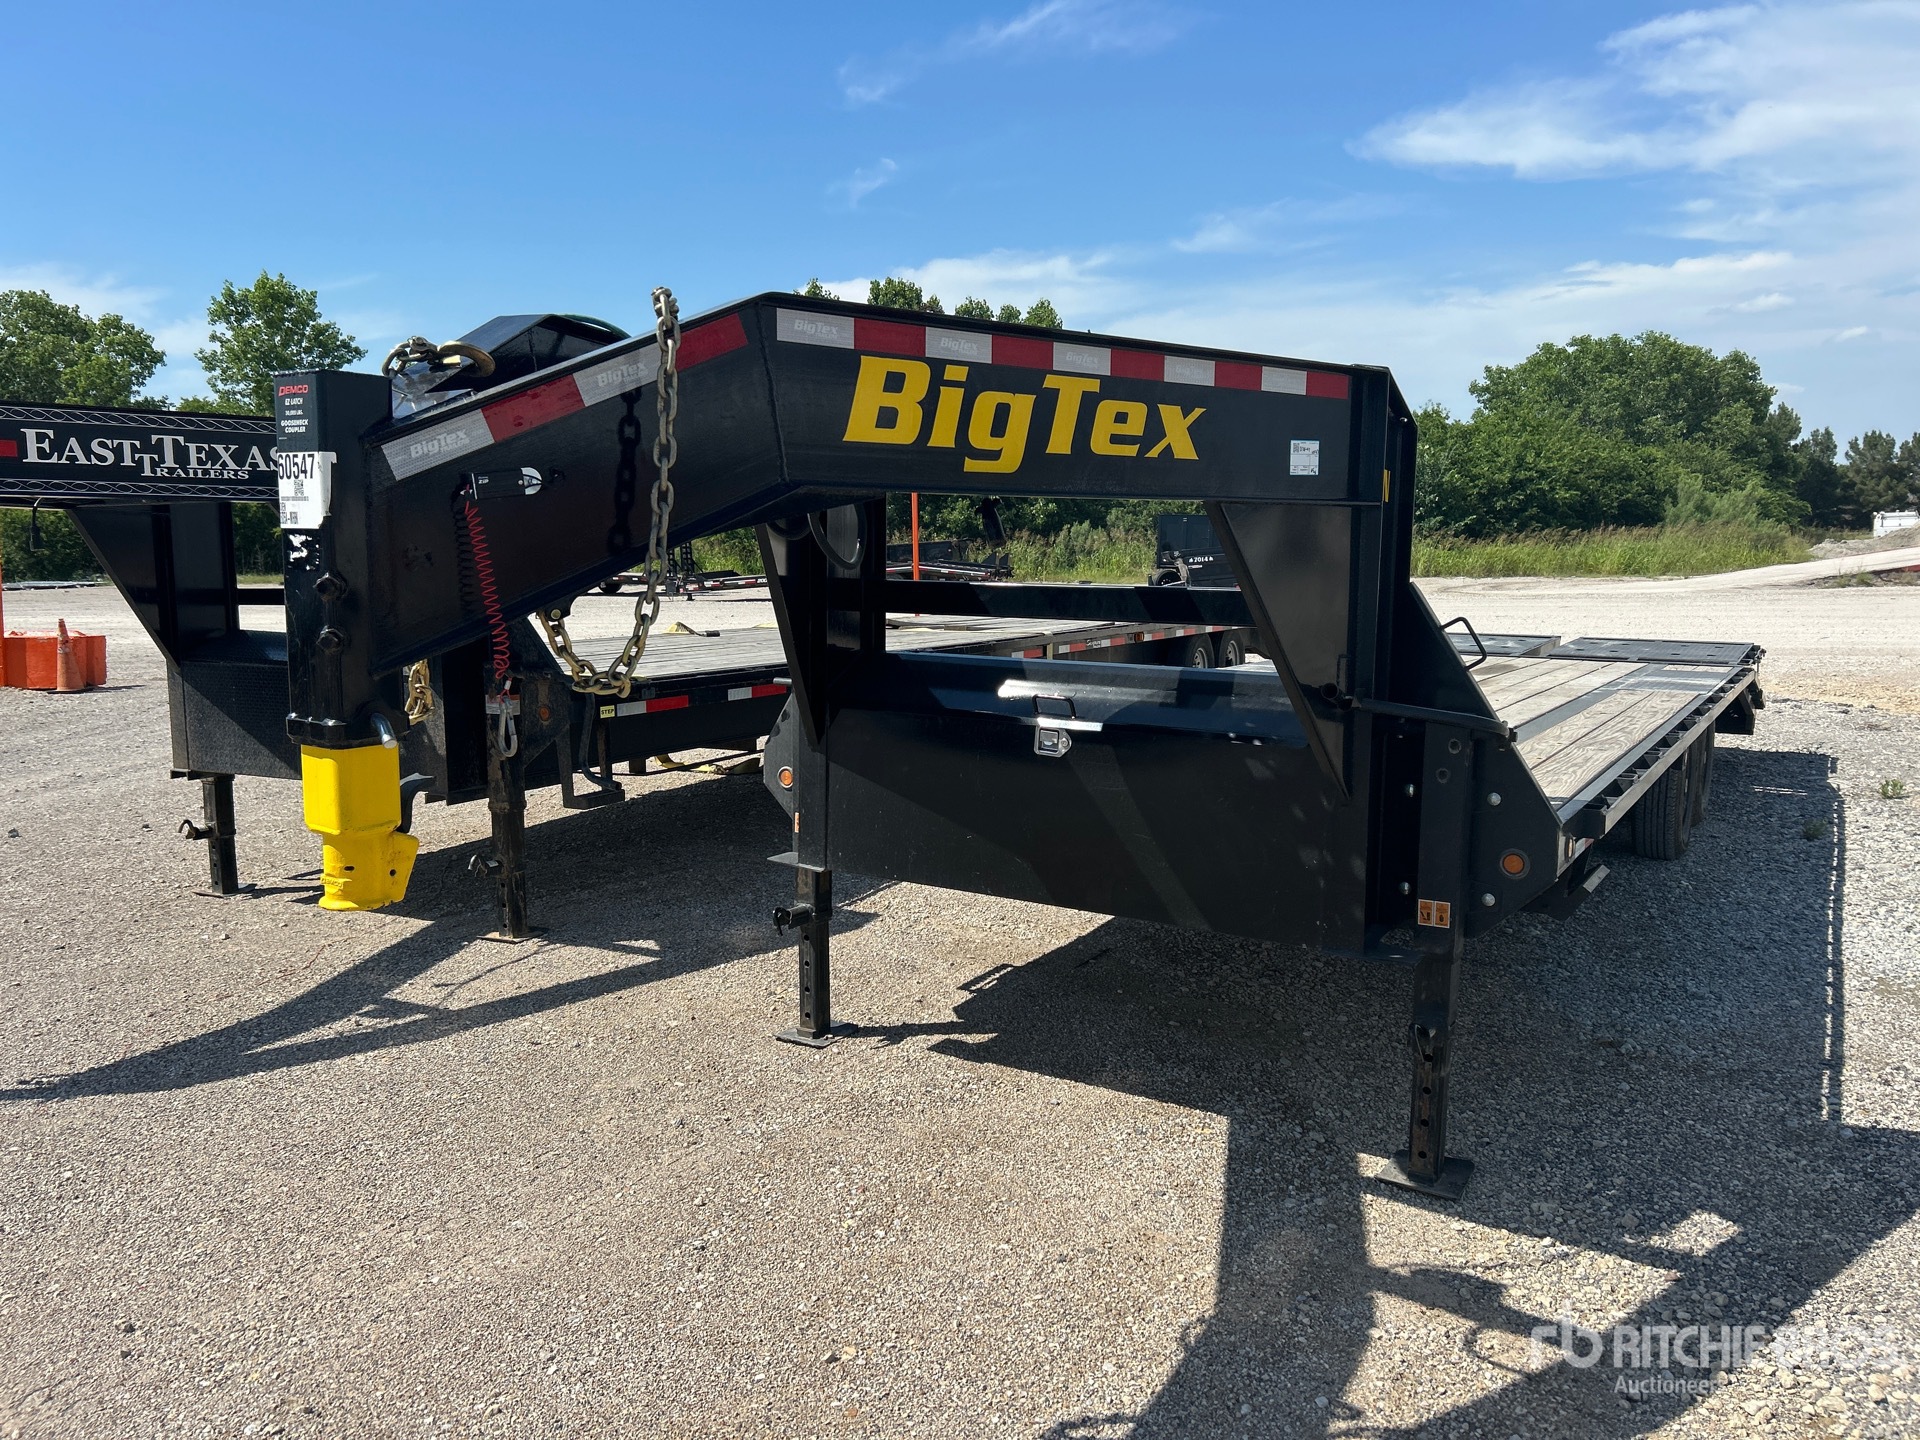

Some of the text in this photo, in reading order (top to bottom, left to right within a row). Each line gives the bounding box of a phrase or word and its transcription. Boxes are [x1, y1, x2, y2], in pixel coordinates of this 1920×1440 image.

[794, 319, 838, 335] BigTex
[941, 337, 978, 351] BigTex
[596, 362, 646, 387] BigTex
[279, 385, 308, 396] DEMCO
[842, 355, 1207, 474] BigTex
[20, 428, 141, 466] EAST
[410, 428, 467, 458] BigTex
[134, 453, 249, 480] TRAILERS
[278, 454, 314, 480] 60547
